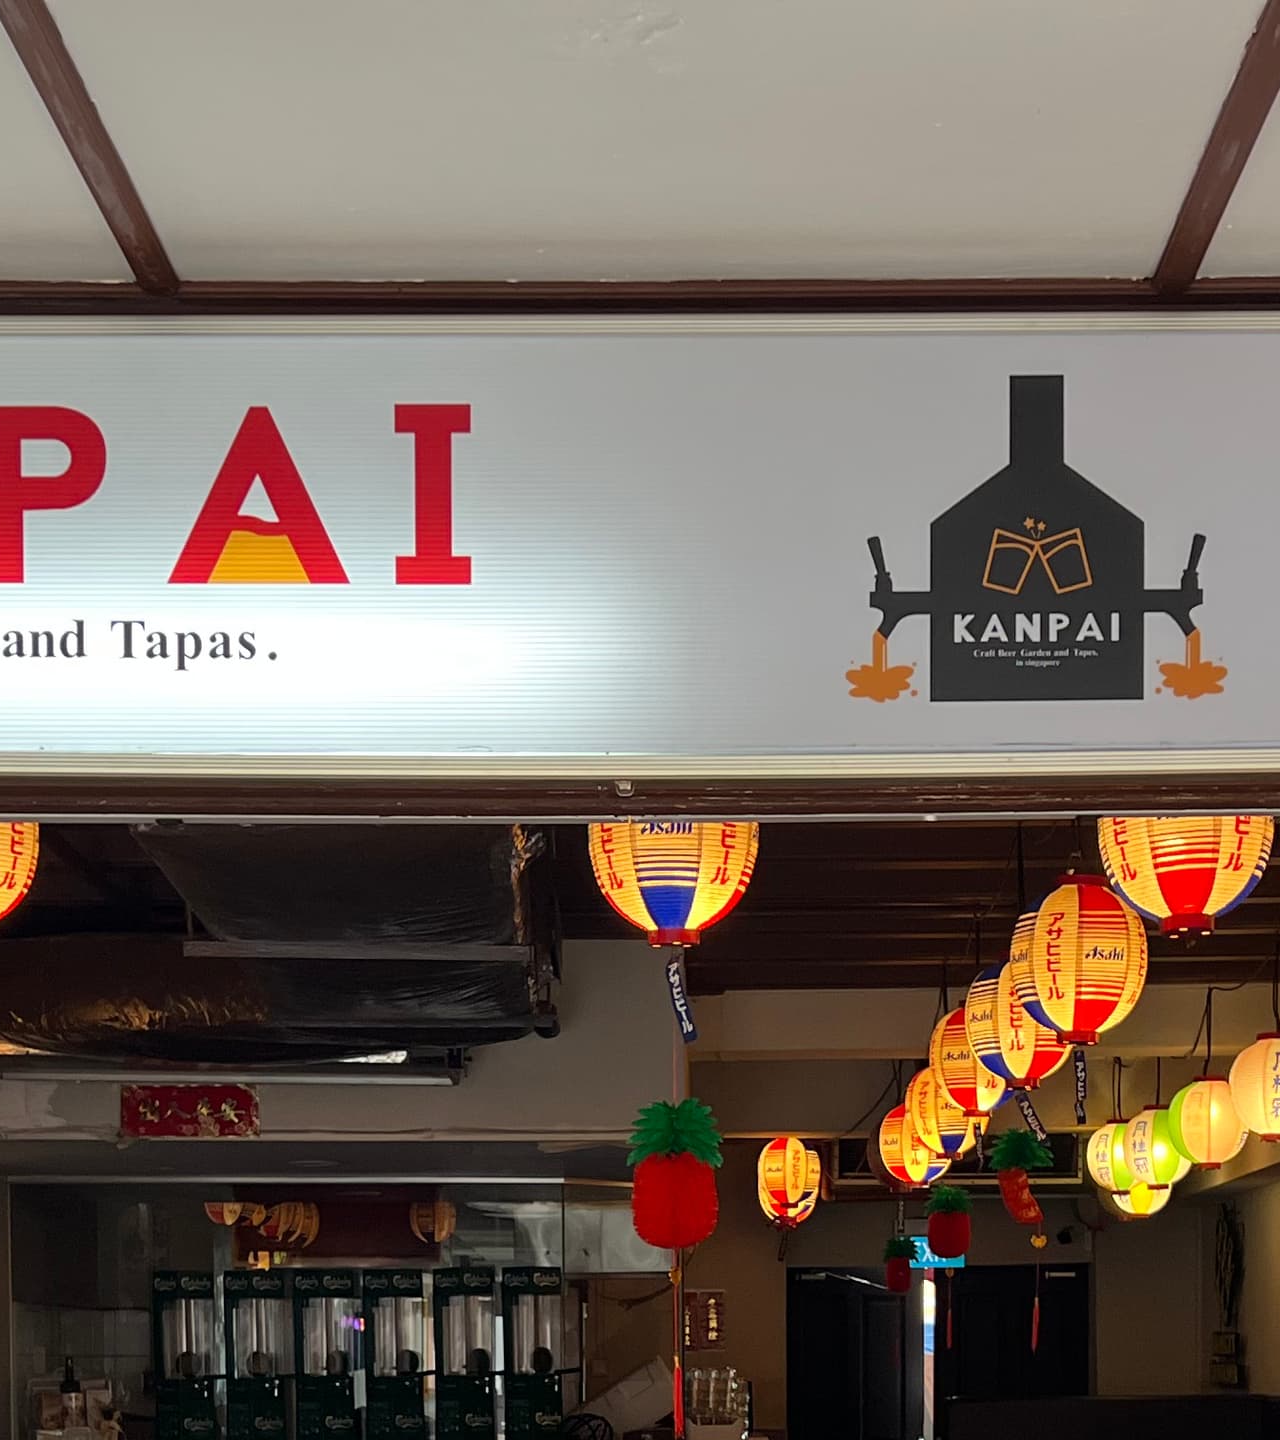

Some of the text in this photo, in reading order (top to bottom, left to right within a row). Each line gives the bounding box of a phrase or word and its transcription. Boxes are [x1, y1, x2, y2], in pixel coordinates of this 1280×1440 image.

[1, 618, 87, 660] and
[110, 619, 279, 672] Tapas.
[953, 612, 1120, 644] KANPAI
[1046, 911, 1065, 1001] アサヒビール
[1085, 945, 1125, 961] Asahi
